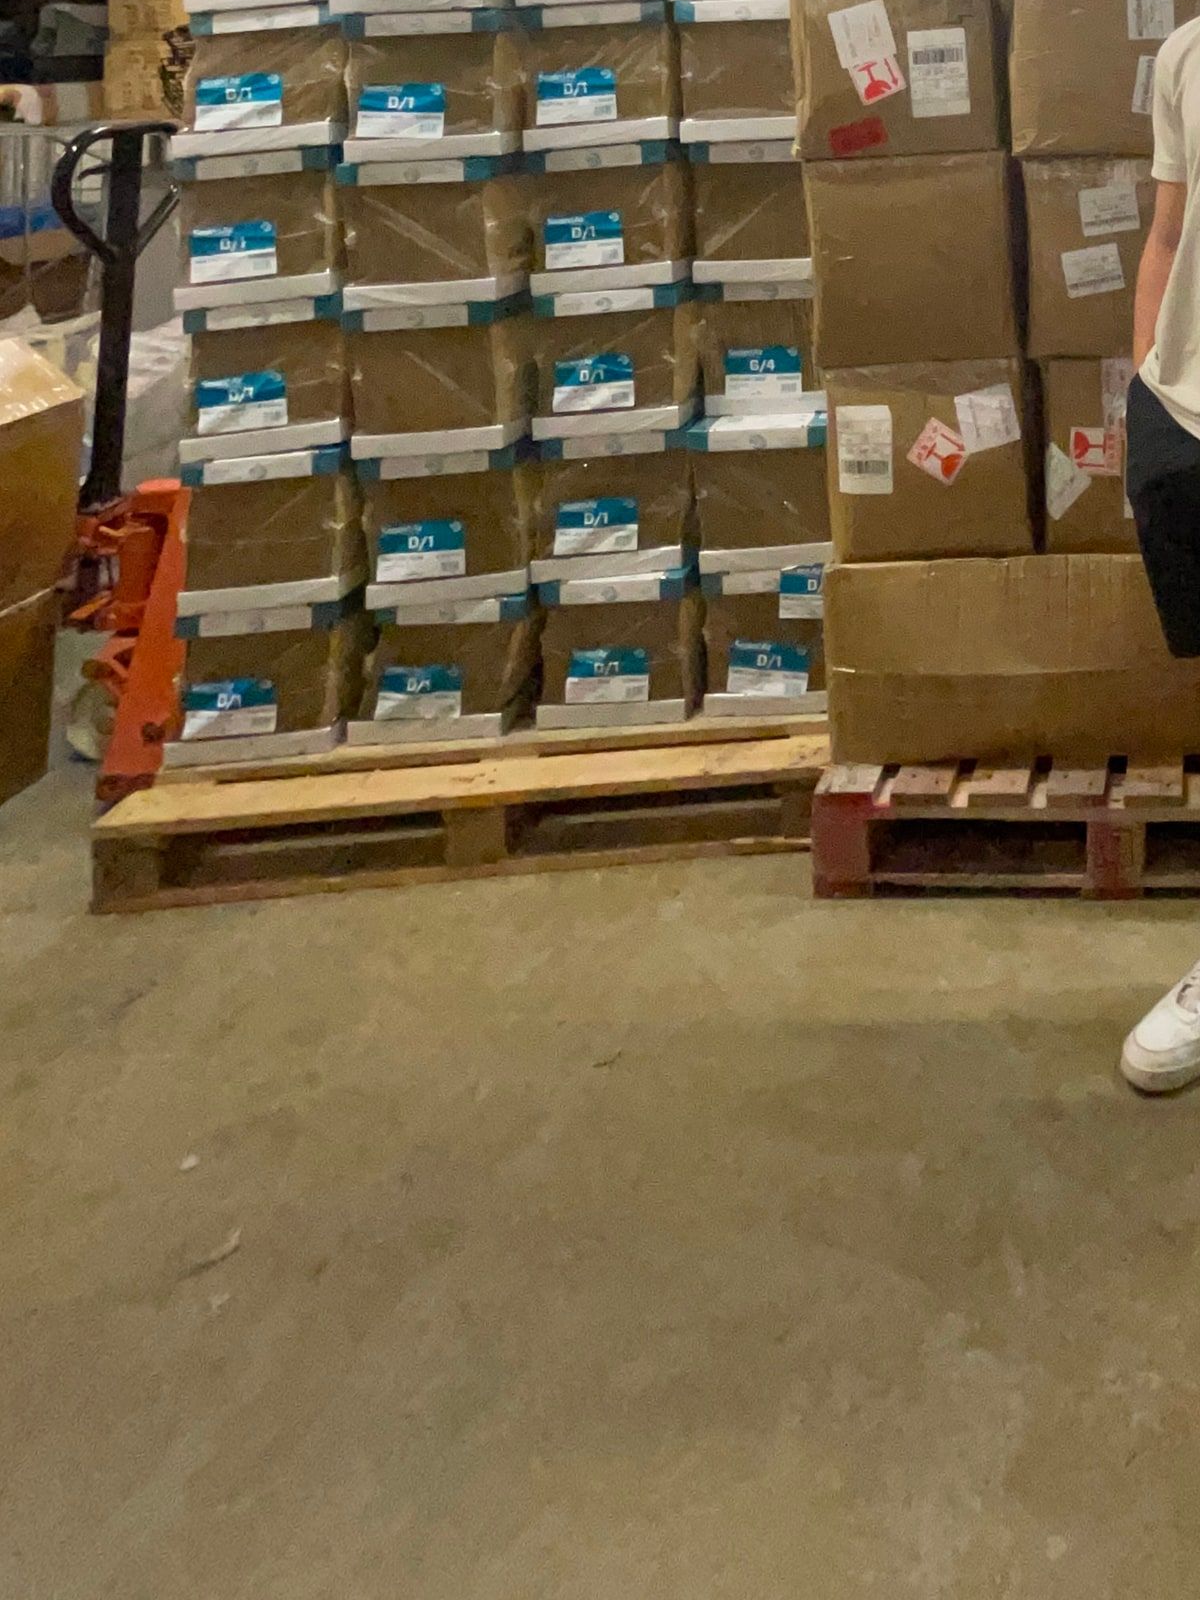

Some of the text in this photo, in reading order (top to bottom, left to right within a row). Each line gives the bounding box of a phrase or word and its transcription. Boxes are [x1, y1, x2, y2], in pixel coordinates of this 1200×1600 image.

[388, 97, 415, 109] D/1
[584, 511, 609, 526] D/1
[408, 535, 434, 551] D/1
[807, 579, 824, 593] D/
[756, 654, 783, 669] D/1
